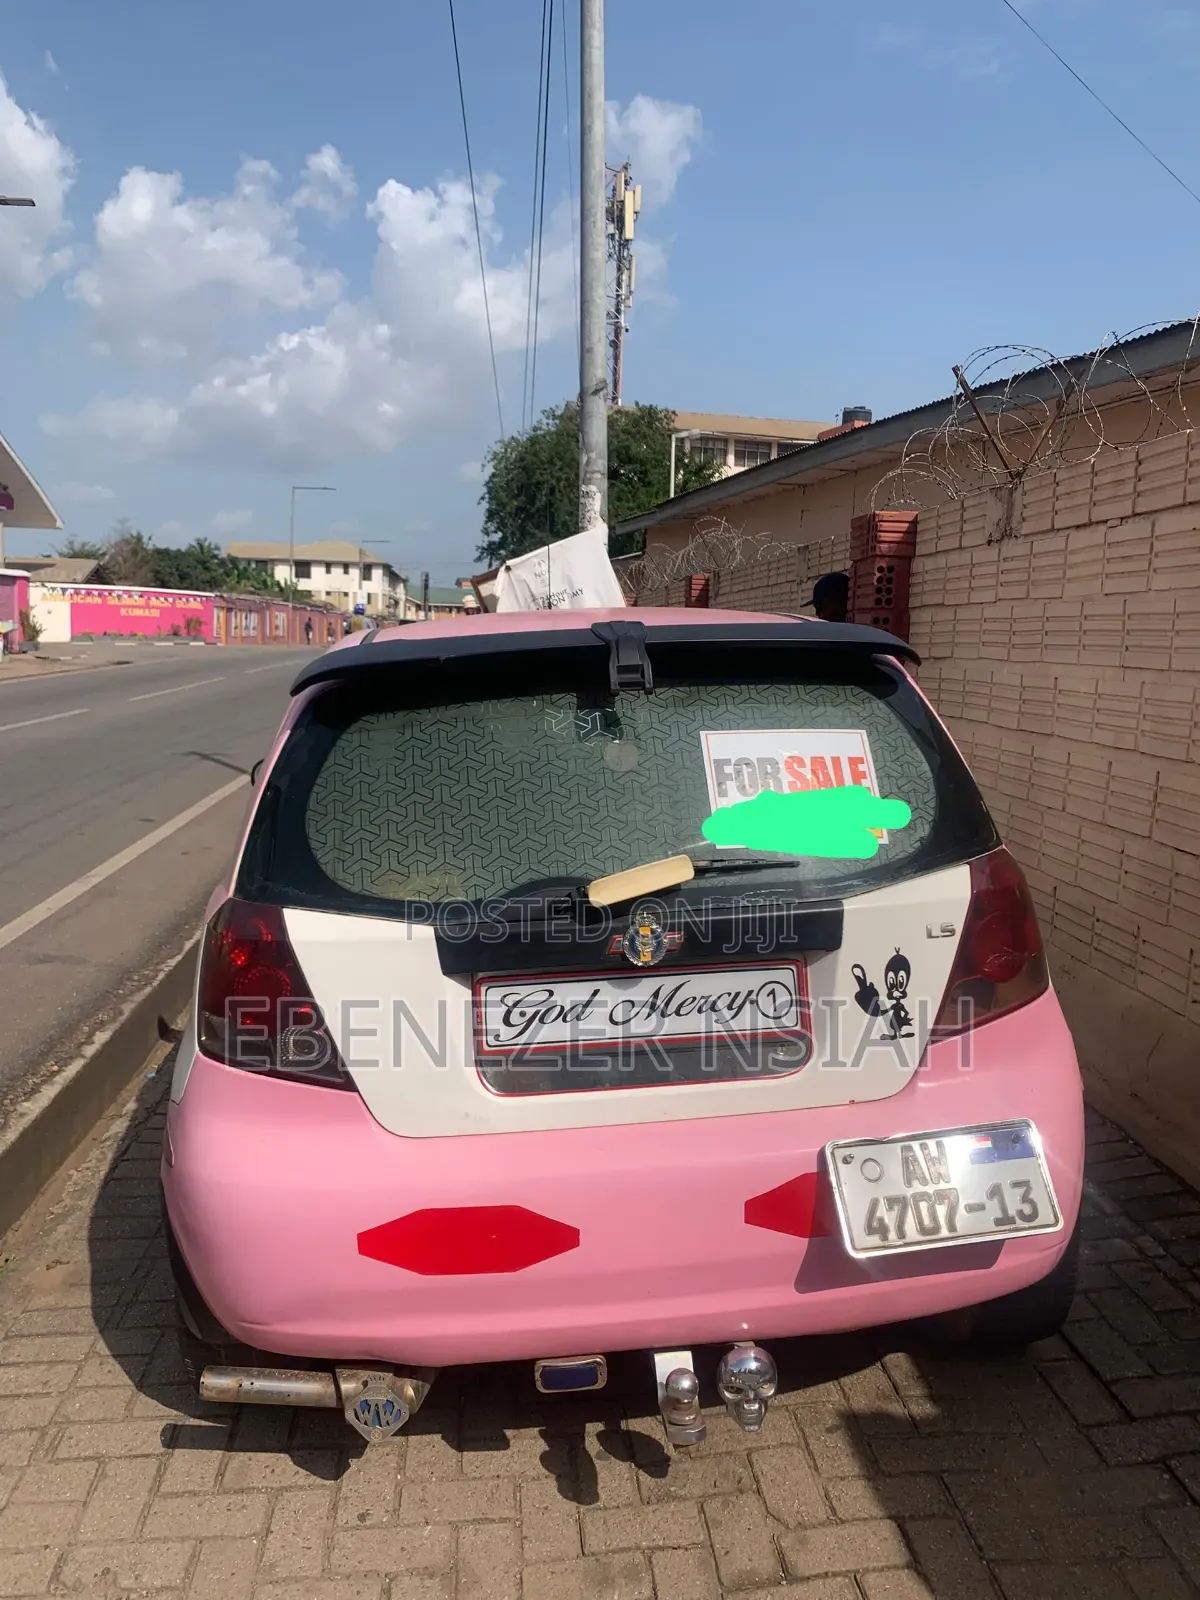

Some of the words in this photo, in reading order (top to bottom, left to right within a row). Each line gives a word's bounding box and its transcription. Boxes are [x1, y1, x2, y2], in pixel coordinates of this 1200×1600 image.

[120, 607, 160, 618] KUMASI
[713, 756, 783, 798] FOR
[784, 755, 871, 794] SALE
[926, 921, 957, 940] LS
[494, 988, 600, 1042] God
[608, 979, 757, 1027] Mercy
[900, 1140, 951, 1188] AW
[865, 1180, 1040, 1242] 4707-13
